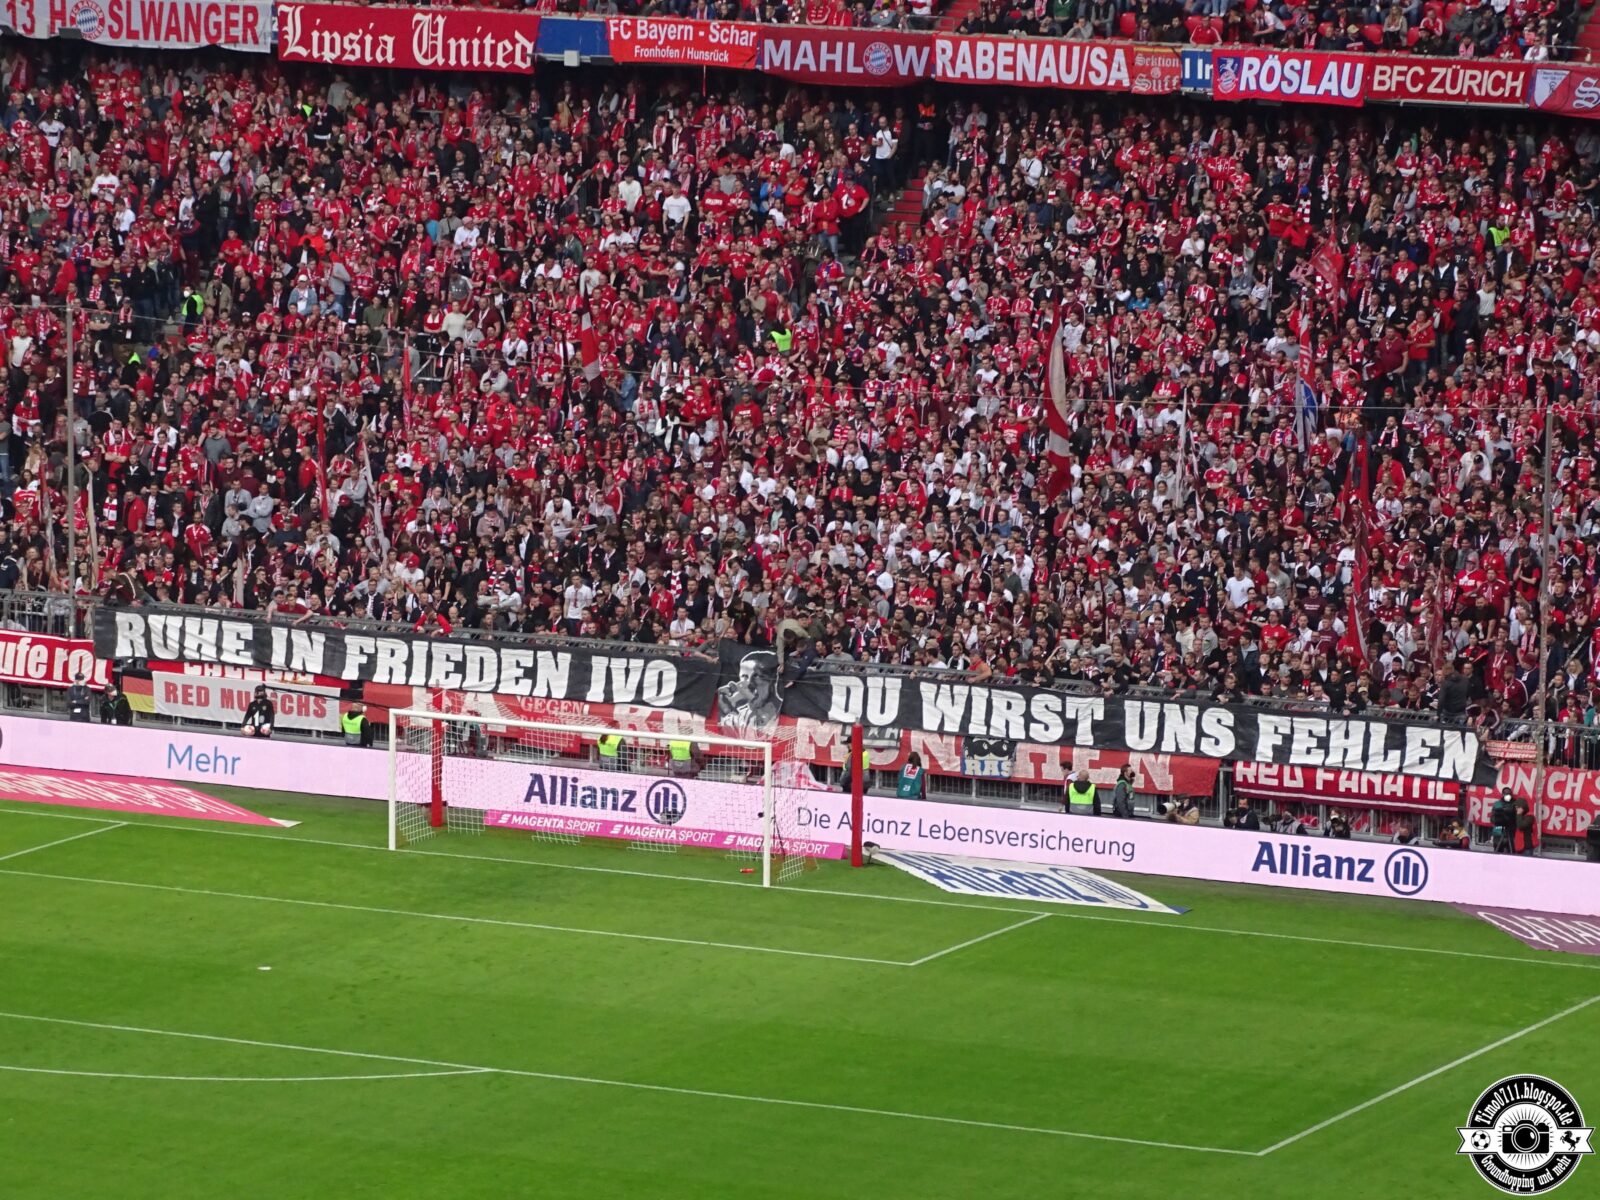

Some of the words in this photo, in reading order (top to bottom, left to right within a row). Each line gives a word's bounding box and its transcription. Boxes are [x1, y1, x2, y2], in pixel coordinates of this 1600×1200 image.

[278, 4, 396, 63] Lipsia
[411, 12, 534, 70] United
[608, 19, 632, 40] FC
[637, 20, 694, 46] Bayern
[709, 22, 757, 47] Schar
[634, 45, 680, 58] Fronhofen
[687, 47, 729, 63] Hunsrück
[935, 38, 1130, 87] RABENAU/SA
[1135, 53, 1179, 67] Sektion
[1239, 54, 1364, 98] RÖSLAU
[1373, 65, 1425, 93] BFC
[1427, 65, 1525, 97] ZÜRICH
[115, 611, 254, 665] RUHE
[270, 627, 326, 674] IN
[341, 634, 573, 699] FRIEDEN
[586, 655, 678, 707] IVO
[828, 675, 902, 726] DU
[920, 681, 1105, 745] WIRST
[1123, 699, 1236, 757] UNS
[1255, 713, 1479, 784] FEHLEN
[164, 681, 210, 708] RED
[167, 743, 241, 775] Mehr
[524, 773, 637, 813] Allianz
[511, 815, 564, 829] MAGENTA
[566, 819, 602, 833] SPORT
[623, 825, 677, 840] MAGENTA
[678, 830, 715, 843] SPORT
[791, 841, 829, 855] SPORT
[797, 806, 831, 829] Die
[917, 817, 1135, 862] Lebensversicherung
[1252, 840, 1375, 883] Allianz
